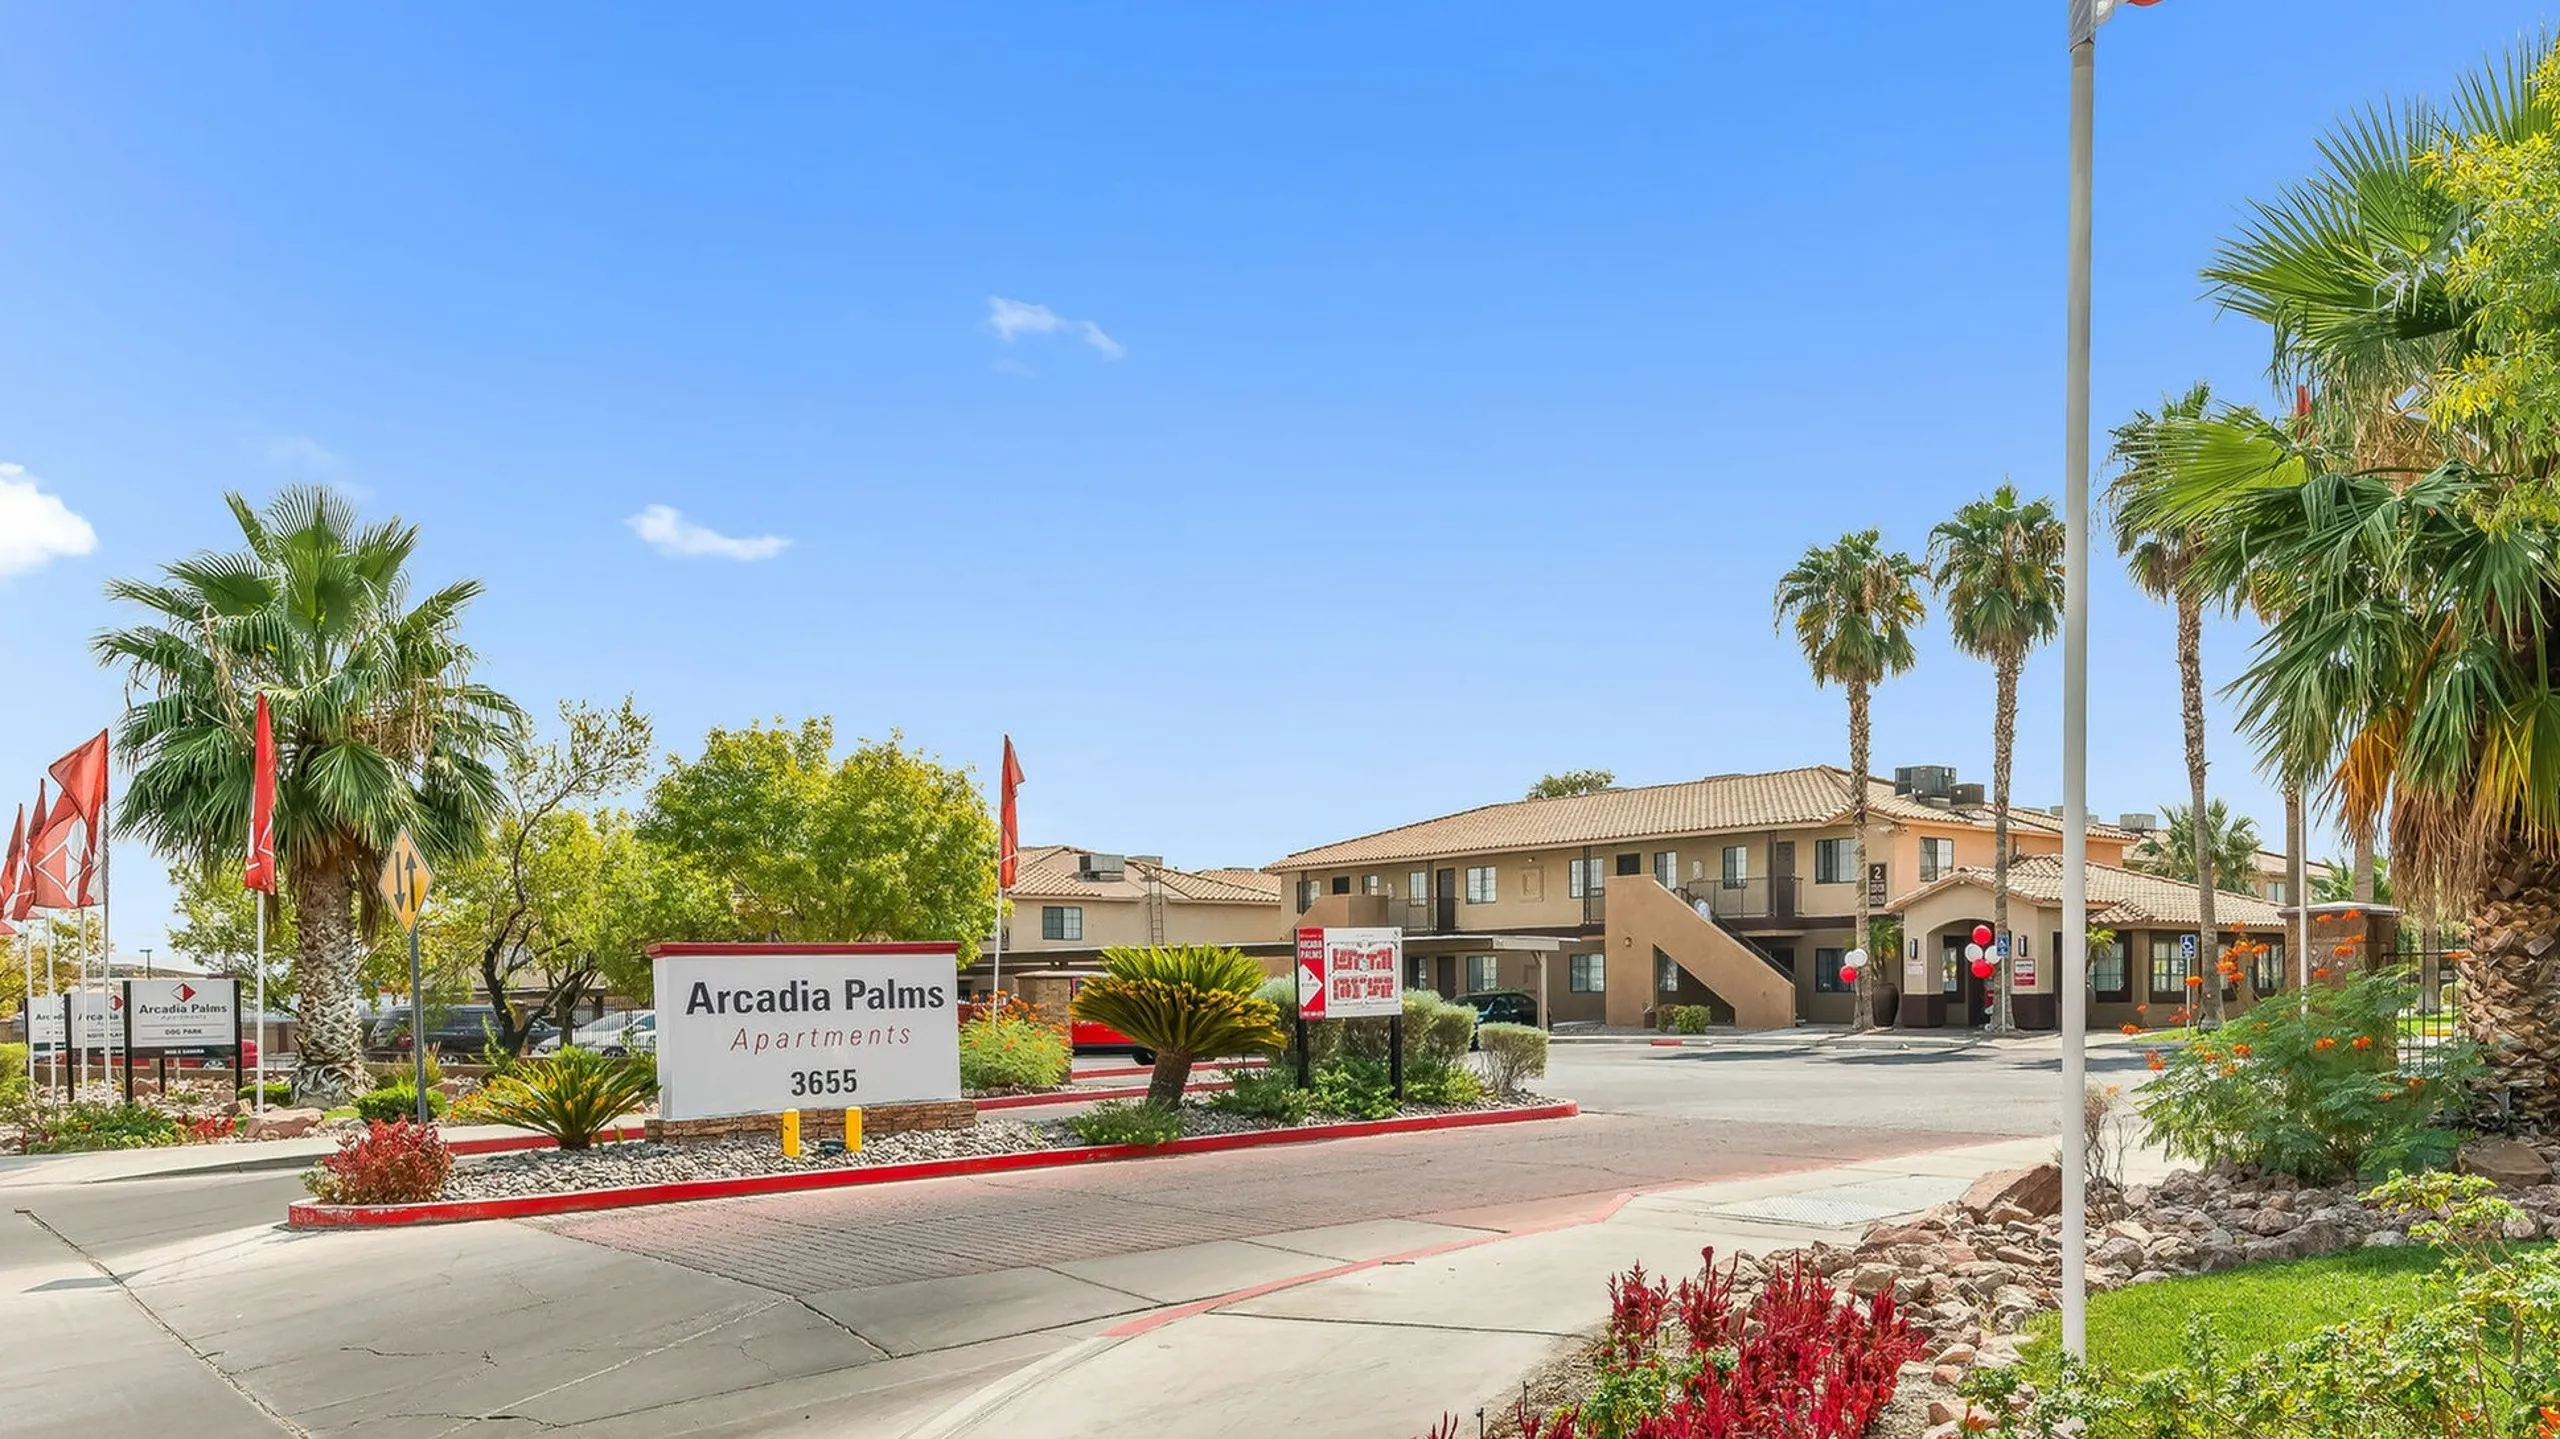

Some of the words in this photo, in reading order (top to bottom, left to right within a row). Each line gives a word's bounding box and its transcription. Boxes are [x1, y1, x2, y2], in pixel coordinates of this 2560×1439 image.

[1873, 866, 1882, 879] 2
[686, 979, 831, 1015] Arcadia
[845, 978, 944, 1011] Palms
[138, 1003, 188, 1014] Arcadia
[191, 1003, 228, 1013] Palms
[164, 1028, 181, 1036] DOG
[730, 1025, 912, 1055] Apartments
[790, 1068, 858, 1096] 3655
